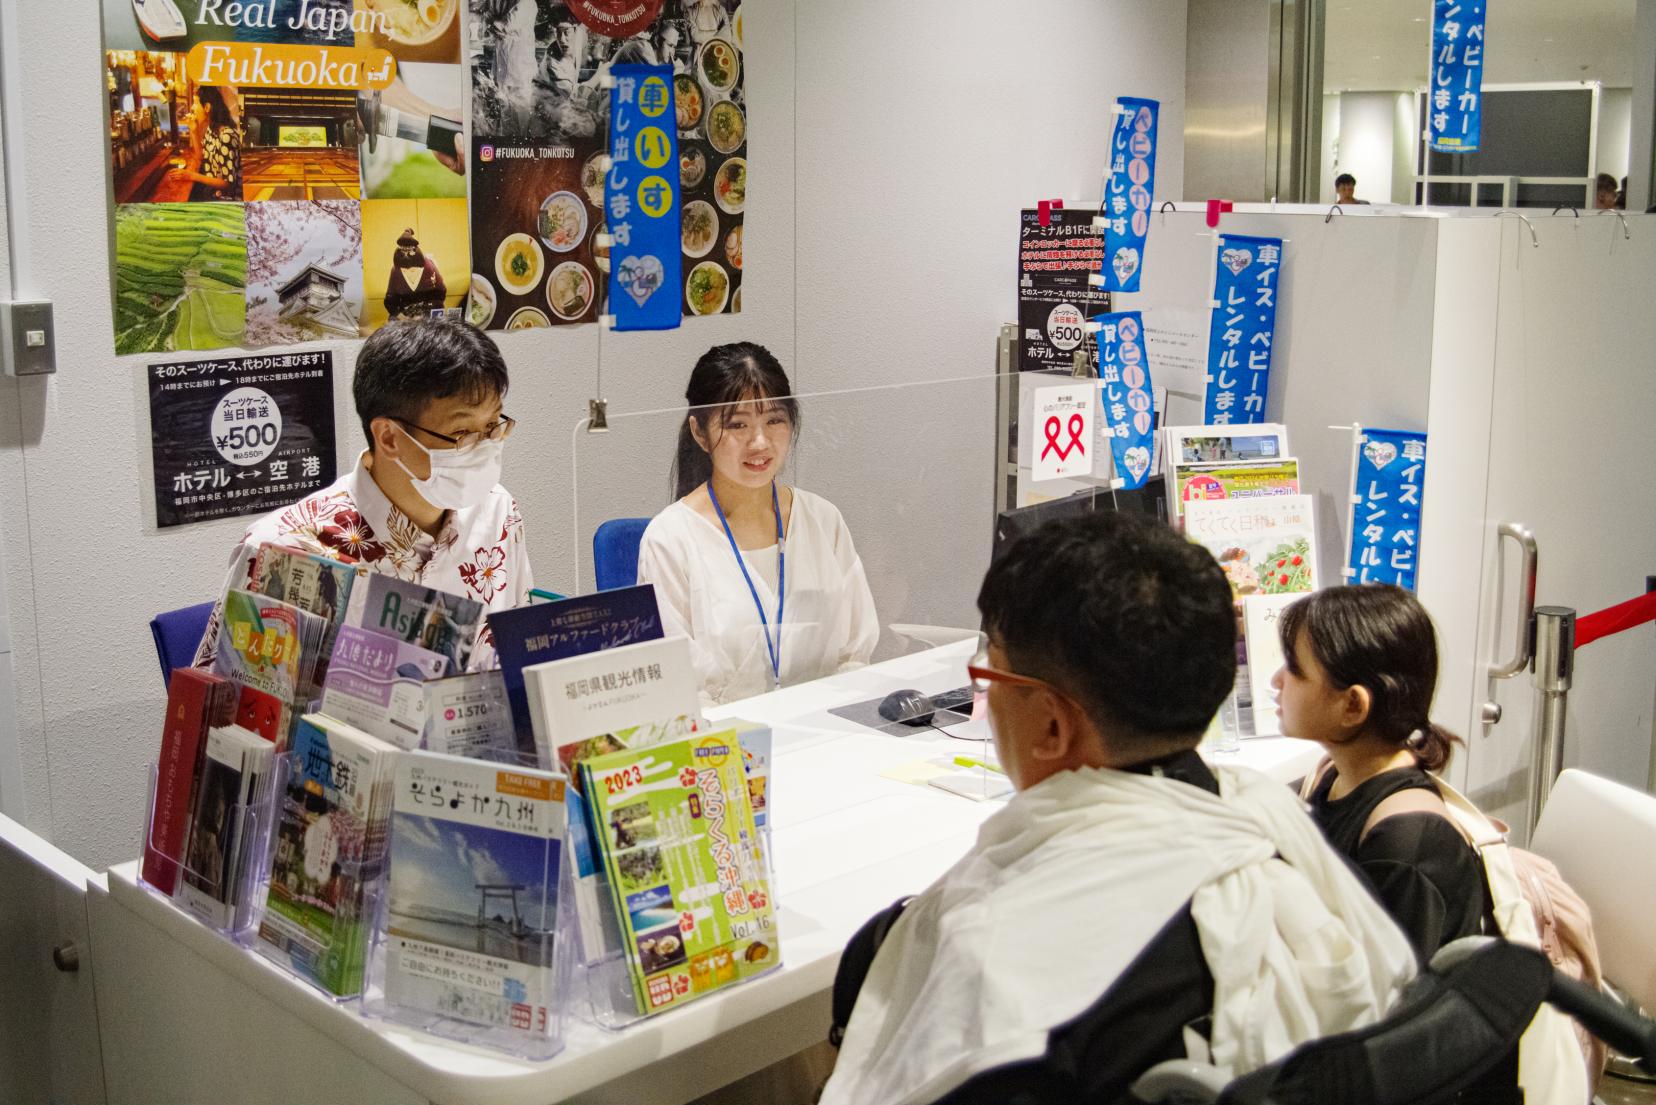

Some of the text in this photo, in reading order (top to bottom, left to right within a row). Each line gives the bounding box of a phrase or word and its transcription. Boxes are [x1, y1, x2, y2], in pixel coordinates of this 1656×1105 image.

[194, 0, 277, 28] Real
[199, 46, 359, 87] Fukuoka
[495, 147, 575, 161] #FUKUOKA_TONKOTSU
[640, 81, 667, 211] 車いす
[609, 77, 636, 247] 貸し出します
[1111, 109, 1136, 236] 貸し出します
[1131, 112, 1149, 231] ベビーカー
[1049, 326, 1082, 342] ¥500
[1028, 346, 1055, 359] ホテル
[1213, 286, 1246, 425] レンタルします
[1102, 322, 1131, 439] 貸し出します
[1119, 323, 1147, 431] ベビーカー
[223, 395, 269, 409] スーツケース
[223, 406, 269, 422] 当日輸送
[216, 422, 278, 450] ¥500
[186, 447, 311, 467] HOTEL AIRPORT
[173, 468, 231, 493] ホテル
[231, 668, 262, 687] Welcome
[565, 663, 663, 700] 福岡県観光情報
[604, 765, 643, 794] 2023
